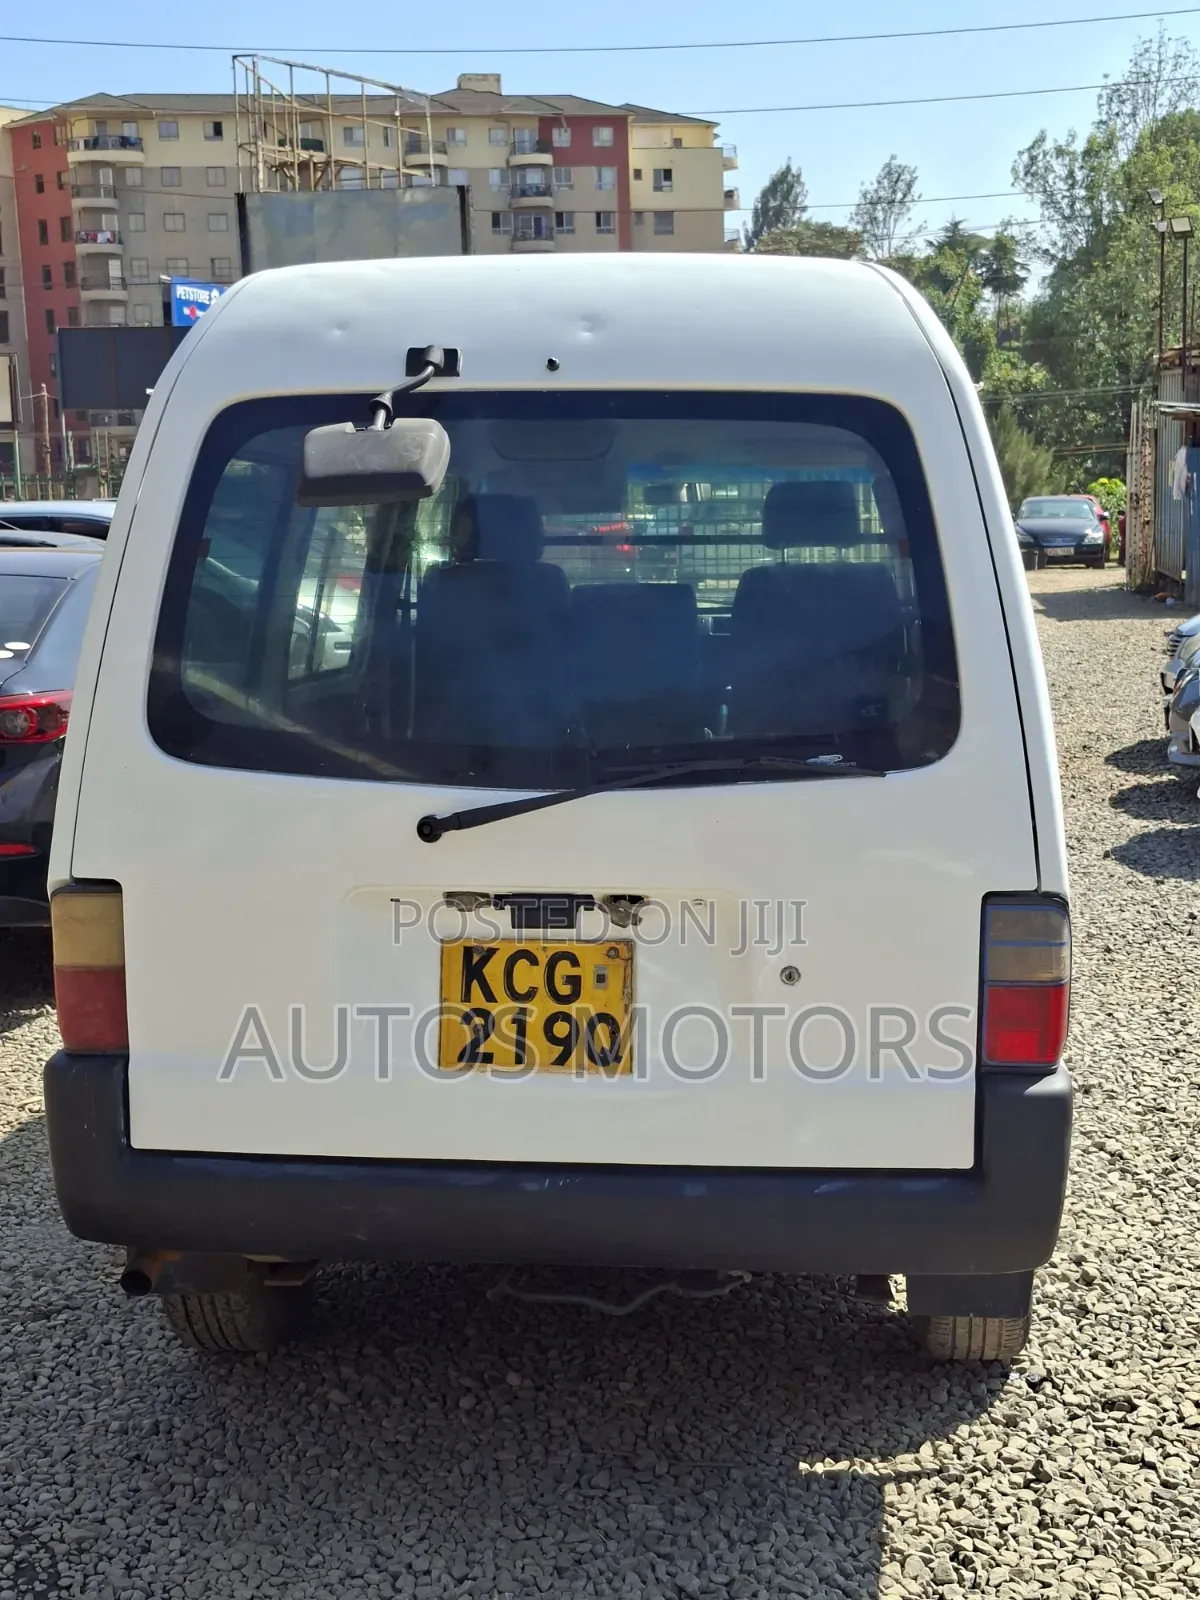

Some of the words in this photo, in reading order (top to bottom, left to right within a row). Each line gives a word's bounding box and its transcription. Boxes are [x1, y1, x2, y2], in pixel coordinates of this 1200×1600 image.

[176, 285, 210, 304] PETSTORE
[460, 945, 582, 1005] KCG
[457, 1008, 623, 1067] 219Q
